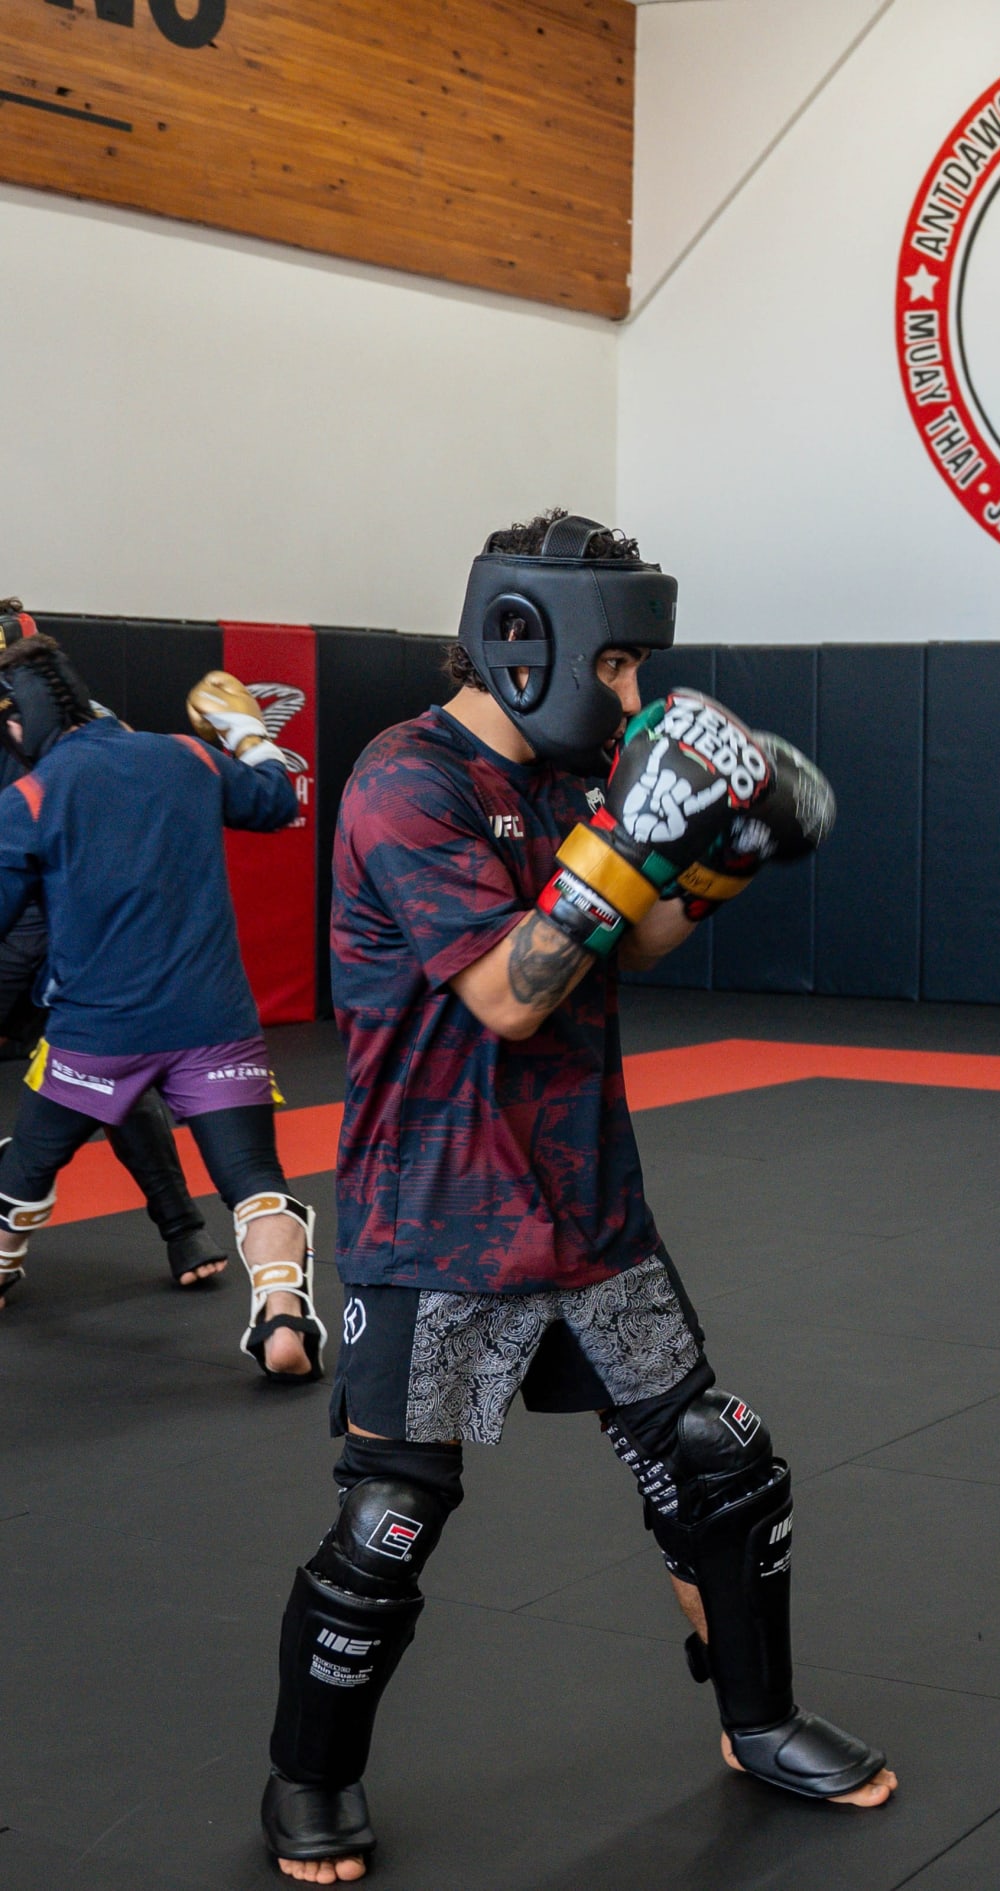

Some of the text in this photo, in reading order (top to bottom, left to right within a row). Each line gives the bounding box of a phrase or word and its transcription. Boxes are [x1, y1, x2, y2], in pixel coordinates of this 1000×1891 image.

[908, 312, 983, 488] MUAY THAI
[488, 814, 524, 838] UFC
[312, 1660, 331, 1675] Shin
